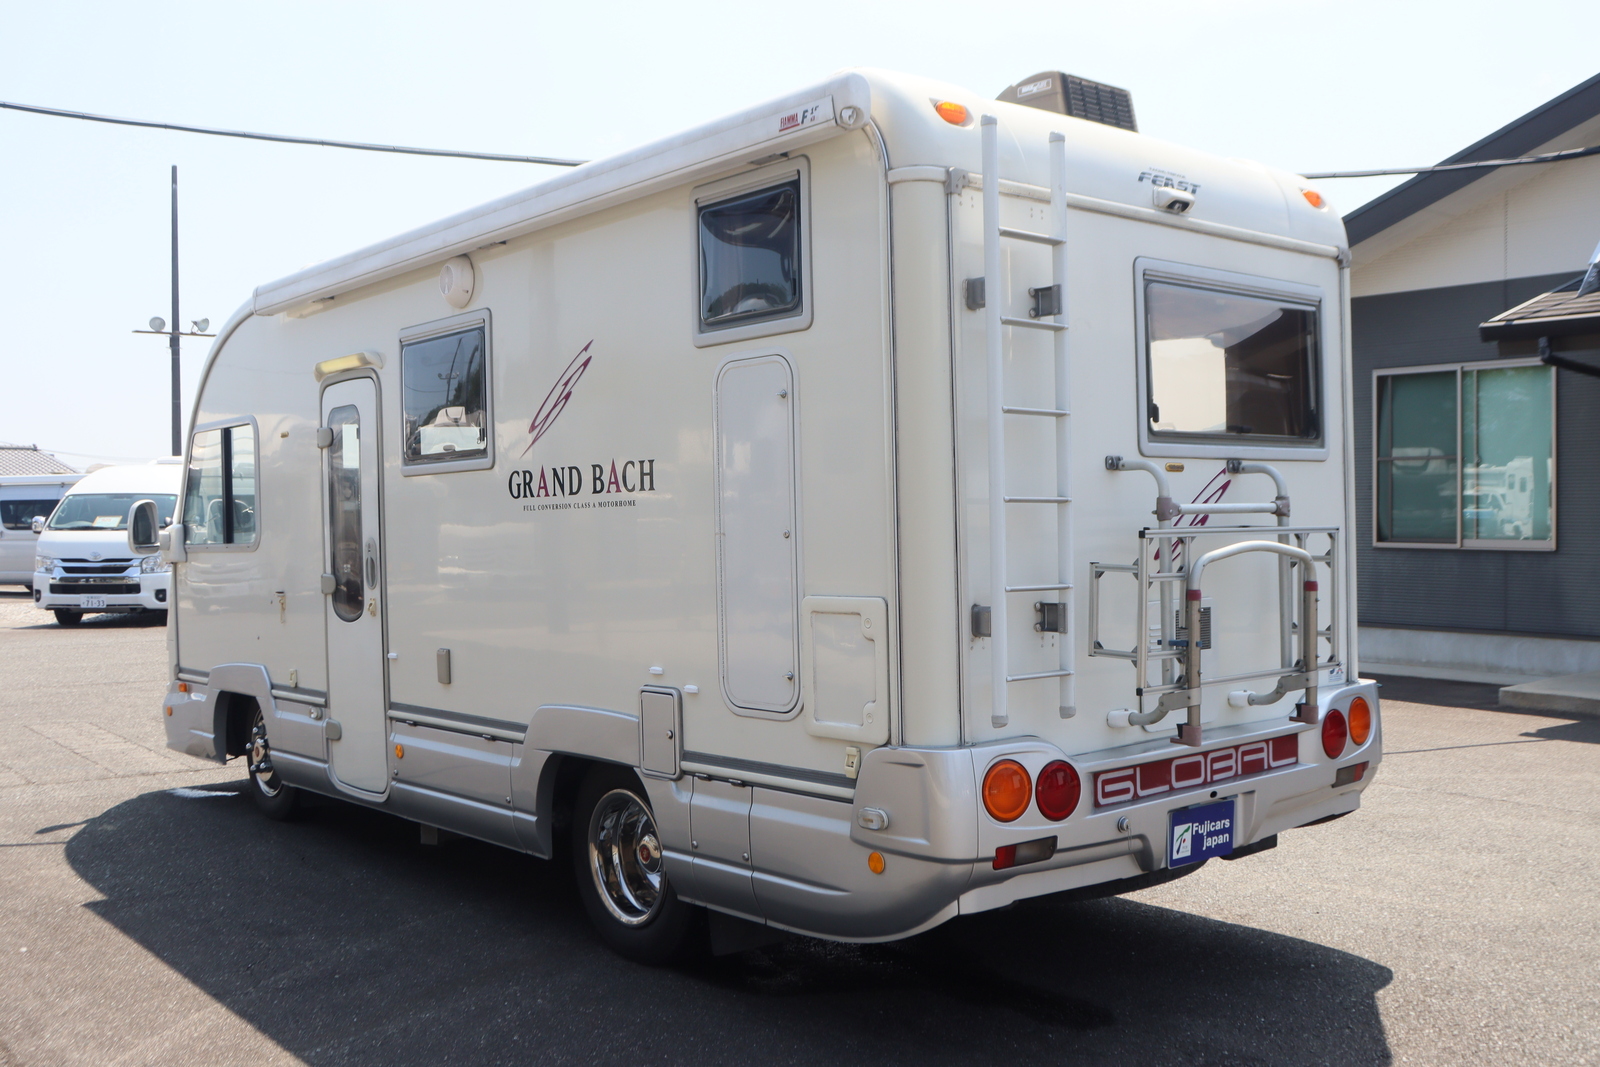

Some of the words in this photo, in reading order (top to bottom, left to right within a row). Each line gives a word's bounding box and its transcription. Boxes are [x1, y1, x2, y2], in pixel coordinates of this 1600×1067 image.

[780, 112, 798, 128] FIAMMA
[1138, 171, 1201, 194] FEAST
[508, 464, 582, 499] GRAND
[591, 457, 655, 494] BACH
[598, 500, 636, 508] MOTORHOME
[1097, 740, 1297, 805] GLOBAL
[1193, 819, 1230, 835] Fujicars
[1203, 833, 1229, 850] japan
